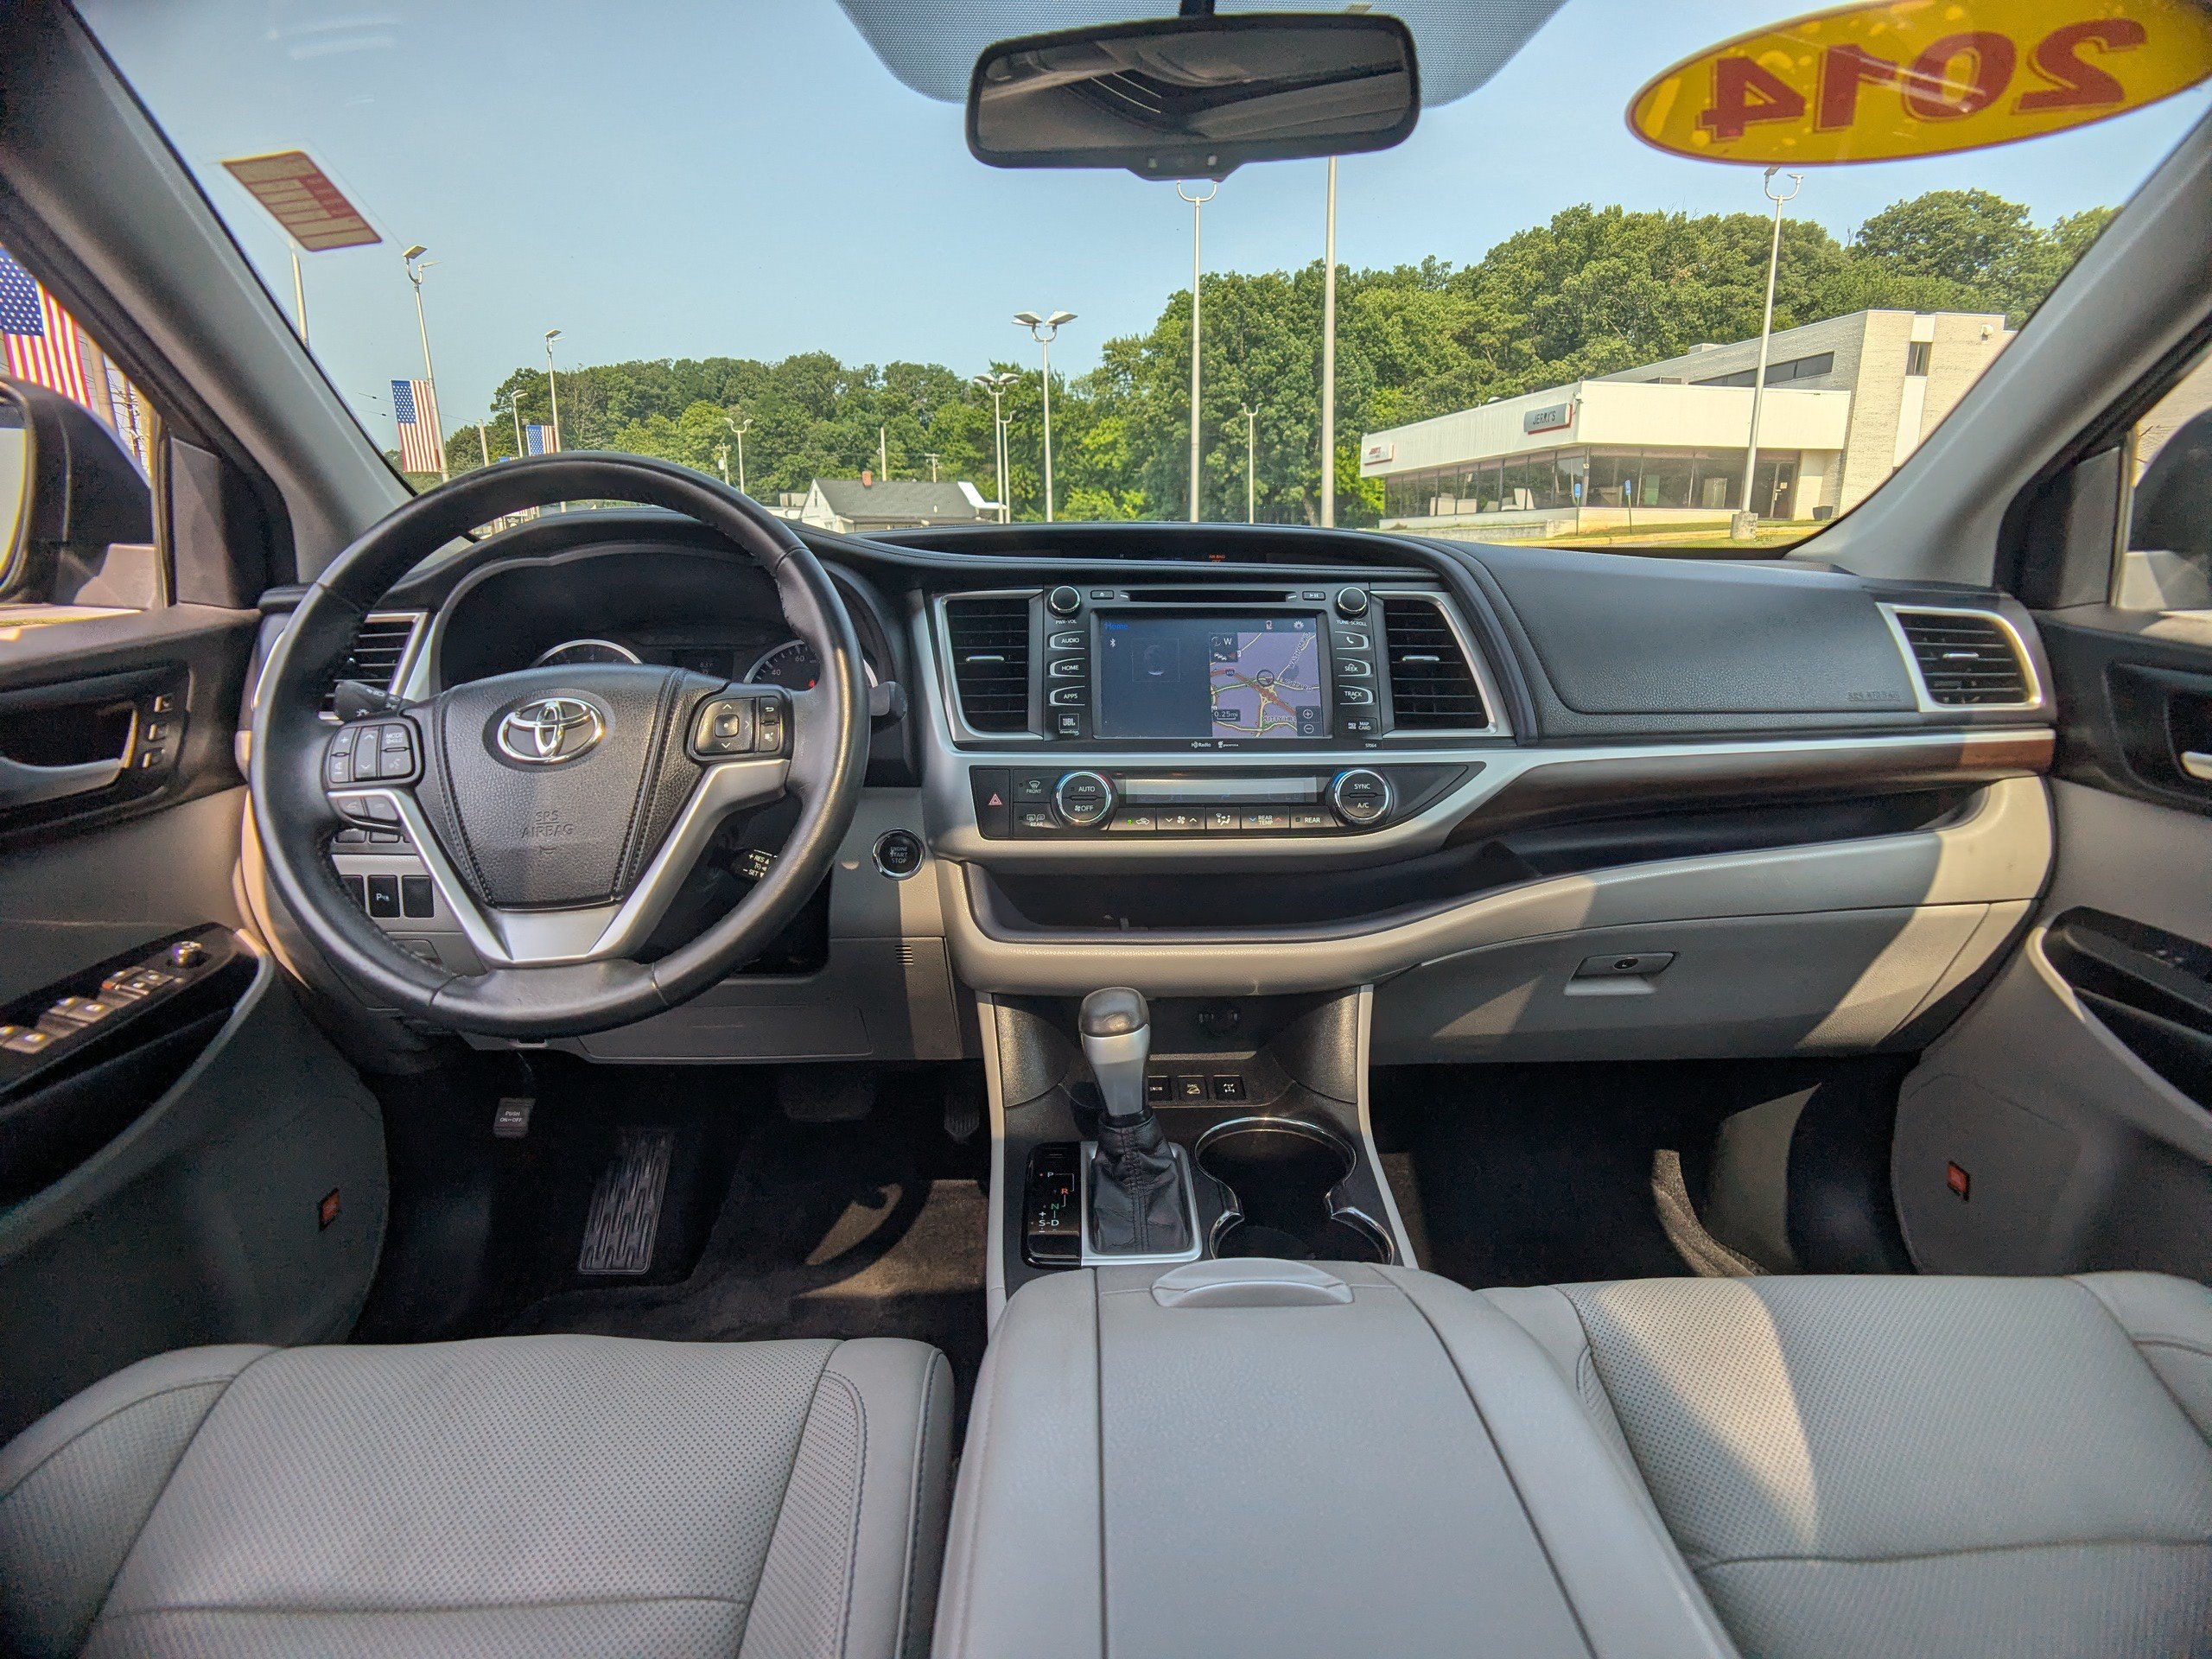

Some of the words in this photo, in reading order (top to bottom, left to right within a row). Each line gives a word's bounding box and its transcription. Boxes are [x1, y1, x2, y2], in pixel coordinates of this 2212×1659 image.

[1103, 621, 1128, 630] Home
[535, 810, 559, 822] SRS
[521, 823, 574, 838] AIRBAG
